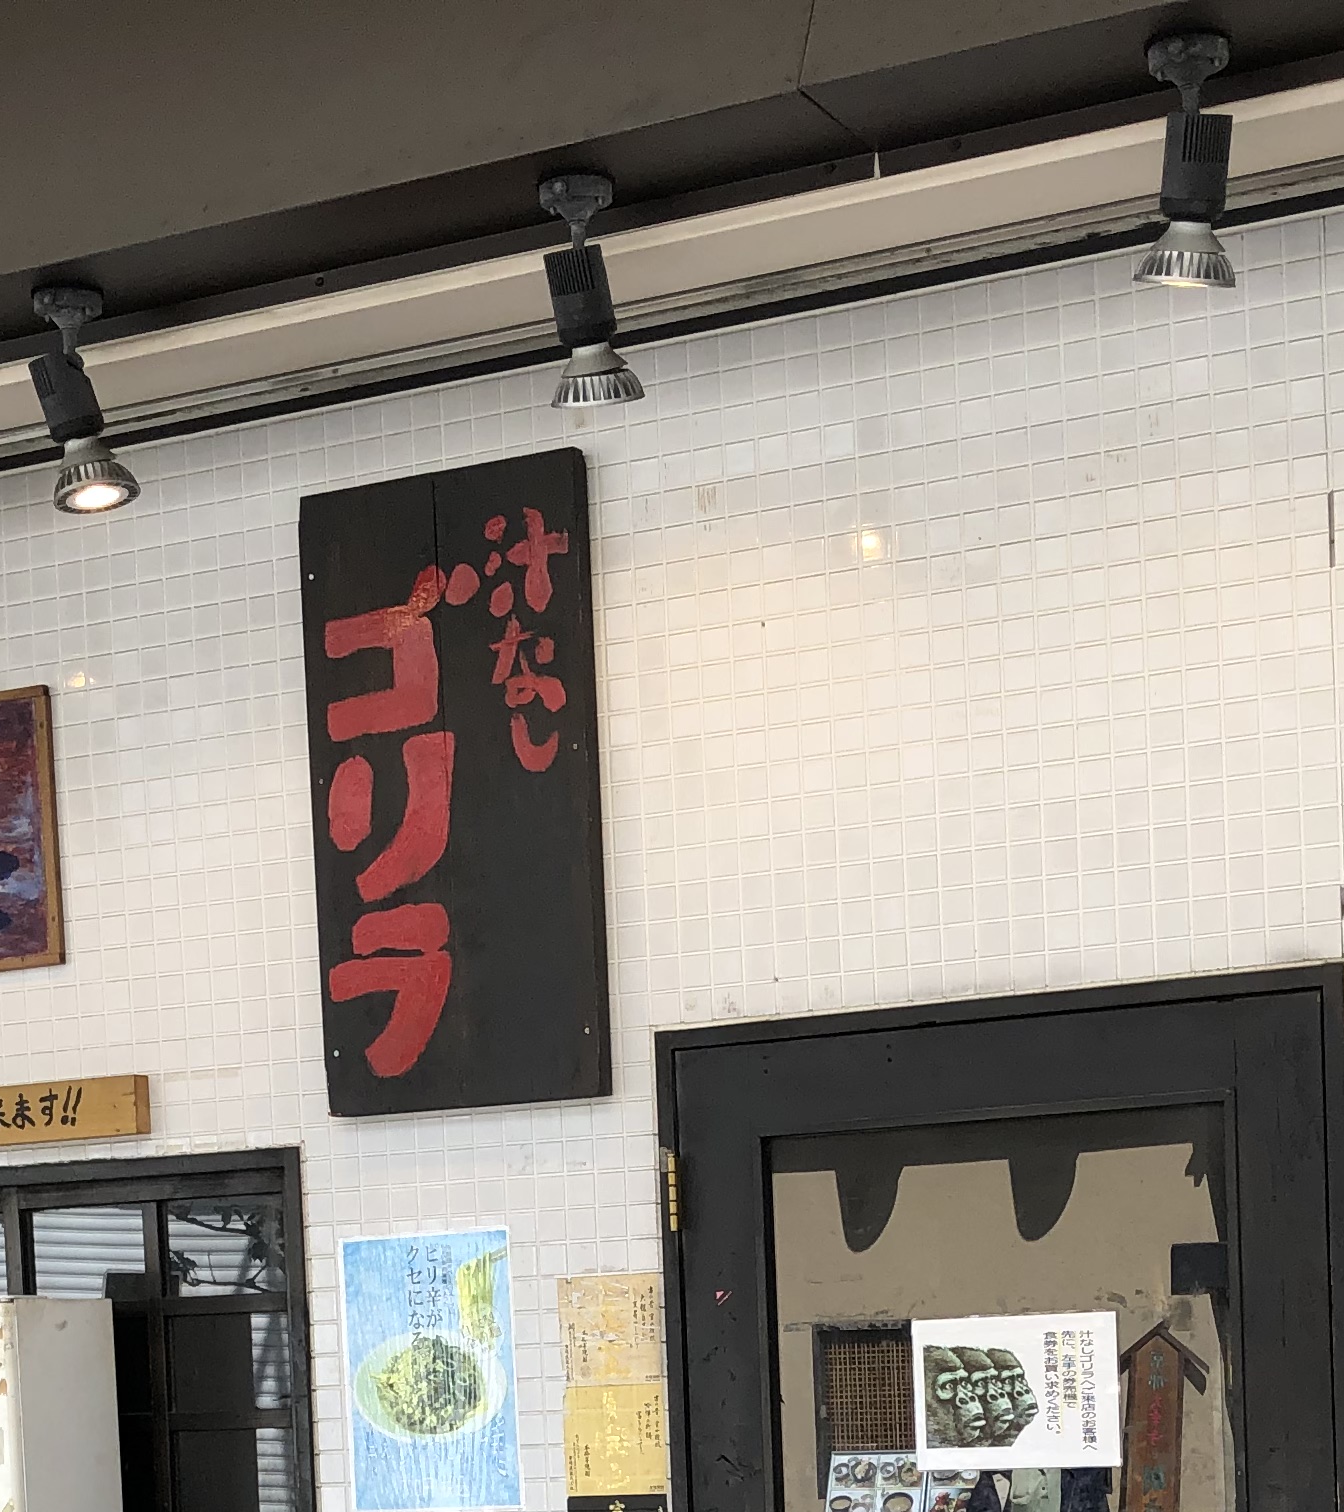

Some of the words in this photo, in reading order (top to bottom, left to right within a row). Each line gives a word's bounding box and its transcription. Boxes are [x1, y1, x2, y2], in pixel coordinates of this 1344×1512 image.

[484, 507, 569, 773] 汁なし
[324, 565, 480, 1079] ゴリラ
[426, 1245, 443, 1328] ピリ辛が
[1079, 1330, 1098, 1450] 汁なしゴリラへご来店のお客様へ
